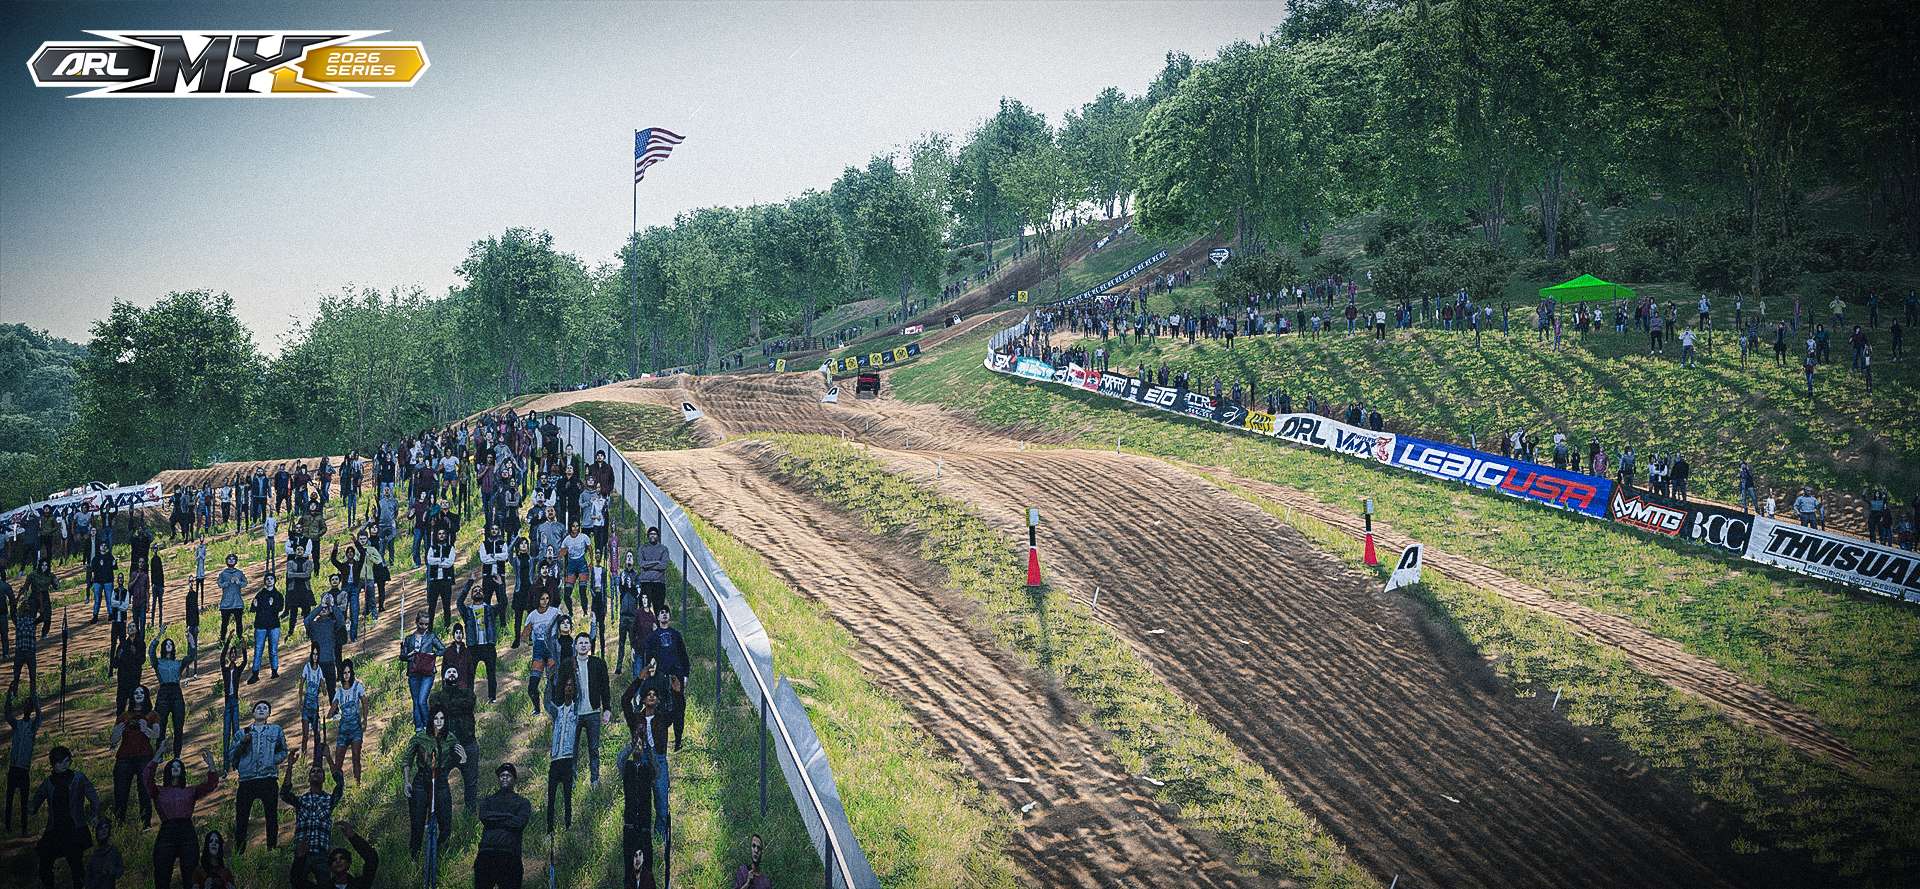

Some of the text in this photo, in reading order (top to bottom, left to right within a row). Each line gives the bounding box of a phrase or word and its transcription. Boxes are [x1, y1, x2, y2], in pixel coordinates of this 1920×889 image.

[1144, 386, 1178, 406] ETO
[1277, 416, 1326, 445] ARL
[1692, 511, 1748, 550] BCC
[1806, 564, 1903, 594] PRECISION MOTO DESIGN
